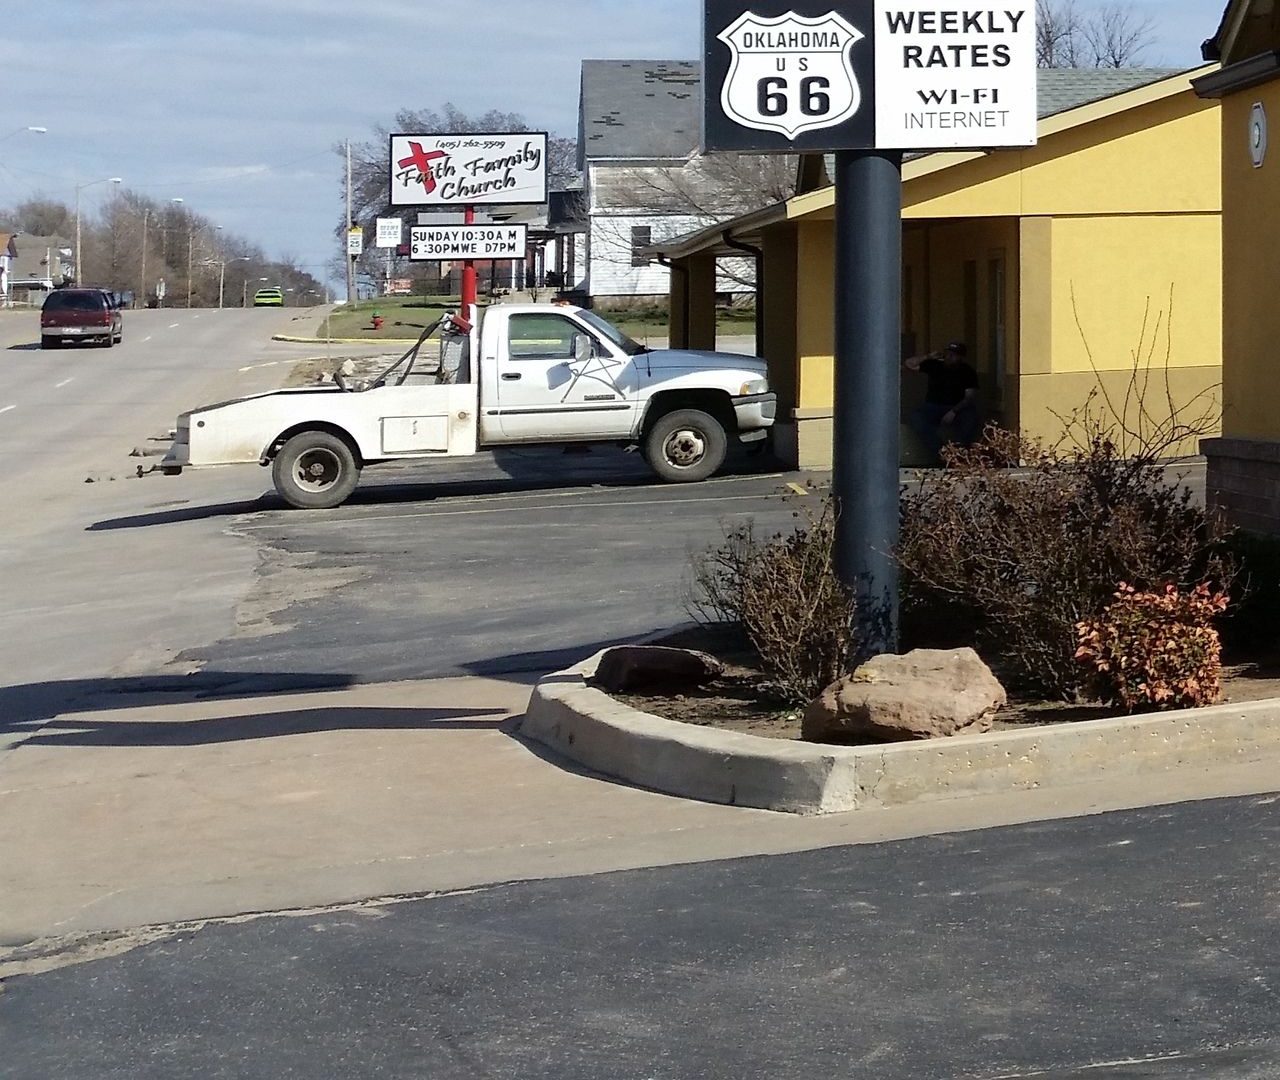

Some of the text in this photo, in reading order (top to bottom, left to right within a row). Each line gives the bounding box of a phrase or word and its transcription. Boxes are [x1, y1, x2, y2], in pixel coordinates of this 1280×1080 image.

[885, 10, 1025, 34] WEEKLY
[743, 31, 840, 49] OKLAHOMA
[903, 44, 1011, 69] RATES
[757, 76, 830, 117] 66
[916, 88, 999, 105] WI-FI
[904, 110, 1010, 130] INTERNET
[435, 139, 461, 151] (405)
[463, 141, 541, 177] Family
[440, 167, 517, 200] Church
[350, 240, 360, 248] 25
[412, 231, 459, 242] SUNDAY
